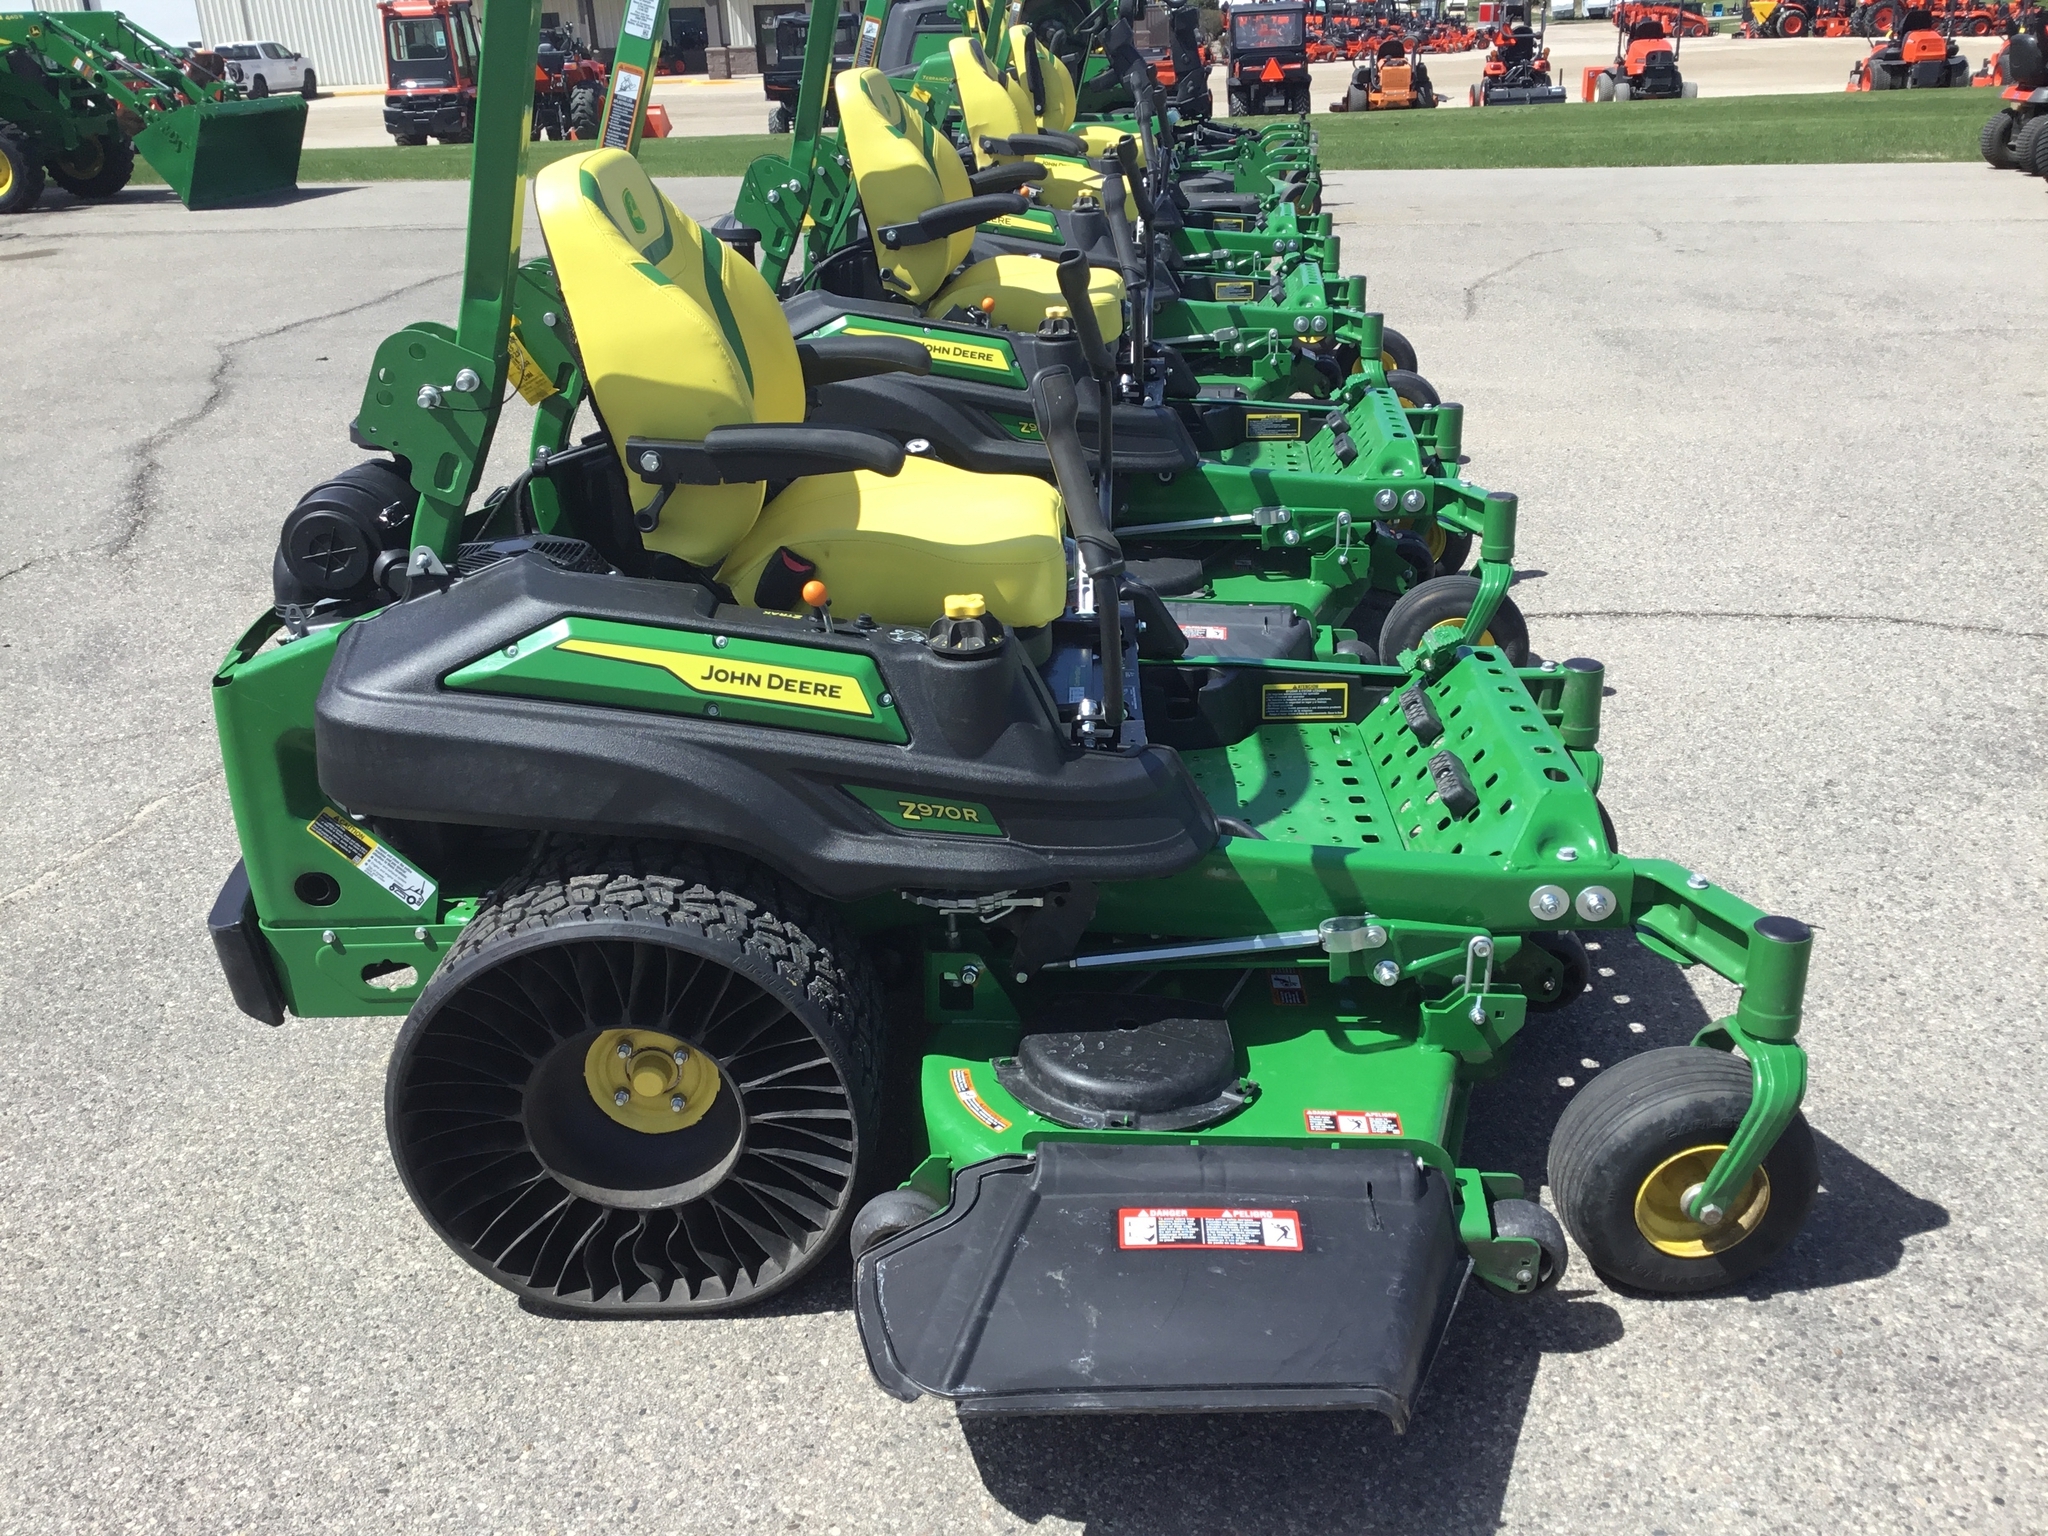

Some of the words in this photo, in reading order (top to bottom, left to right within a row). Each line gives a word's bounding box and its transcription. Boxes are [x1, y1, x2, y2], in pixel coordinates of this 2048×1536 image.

[952, 347, 994, 362] DEERE
[700, 665, 762, 688] JOHN
[767, 673, 842, 699] DEERE
[898, 800, 980, 823] Z970R
[339, 818, 366, 840] CAUTION
[1150, 1209, 1188, 1217] DANGER
[1232, 1210, 1274, 1218] PELIGRO
